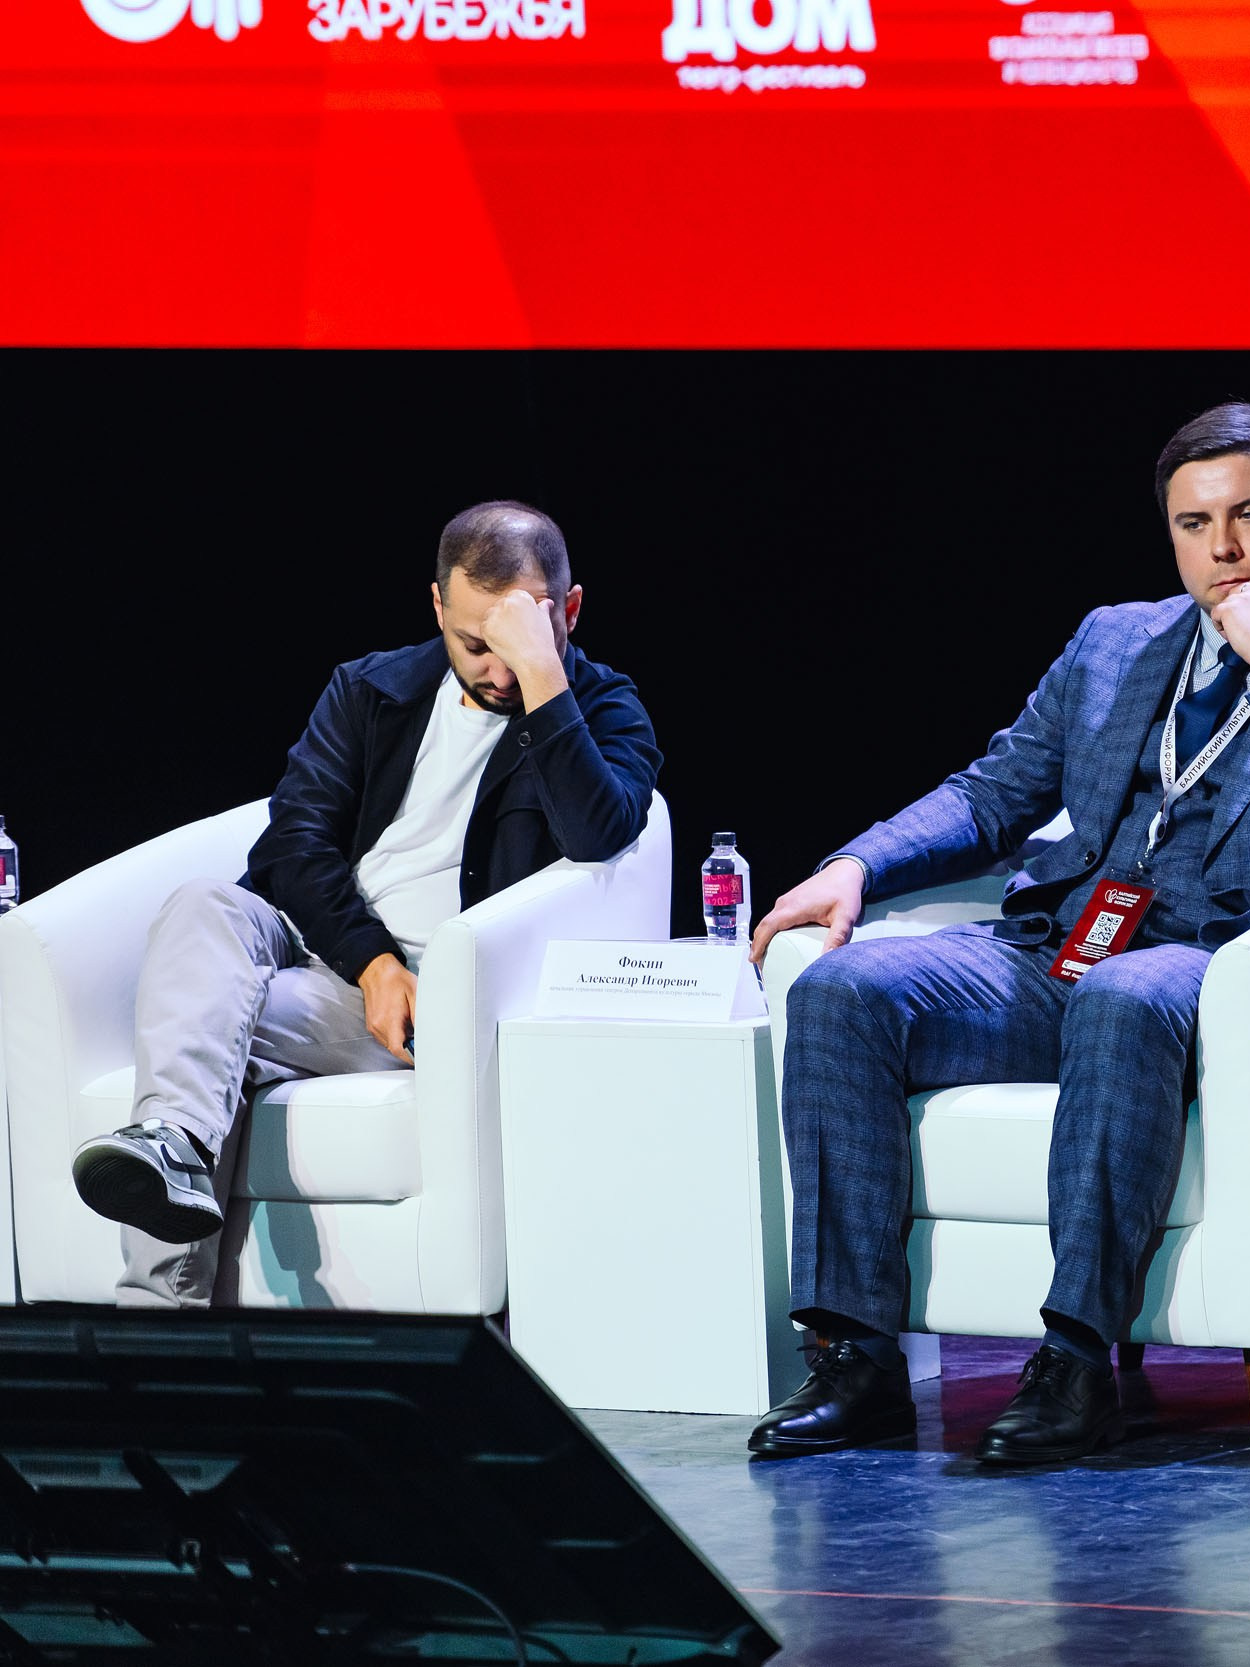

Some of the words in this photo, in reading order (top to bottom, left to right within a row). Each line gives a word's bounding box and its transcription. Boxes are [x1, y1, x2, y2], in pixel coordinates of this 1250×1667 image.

[308, 0, 586, 41] ЗАРУБЕЖЬЯ
[662, 0, 877, 62] ДОМ
[1179, 736, 1224, 788] БАЛТИЙСКИЙ
[1222, 702, 1250, 738] КУЛЬТУРН
[577, 972, 638, 987] Александр
[641, 975, 698, 988] Игоревич
[618, 956, 663, 969] Фокин
